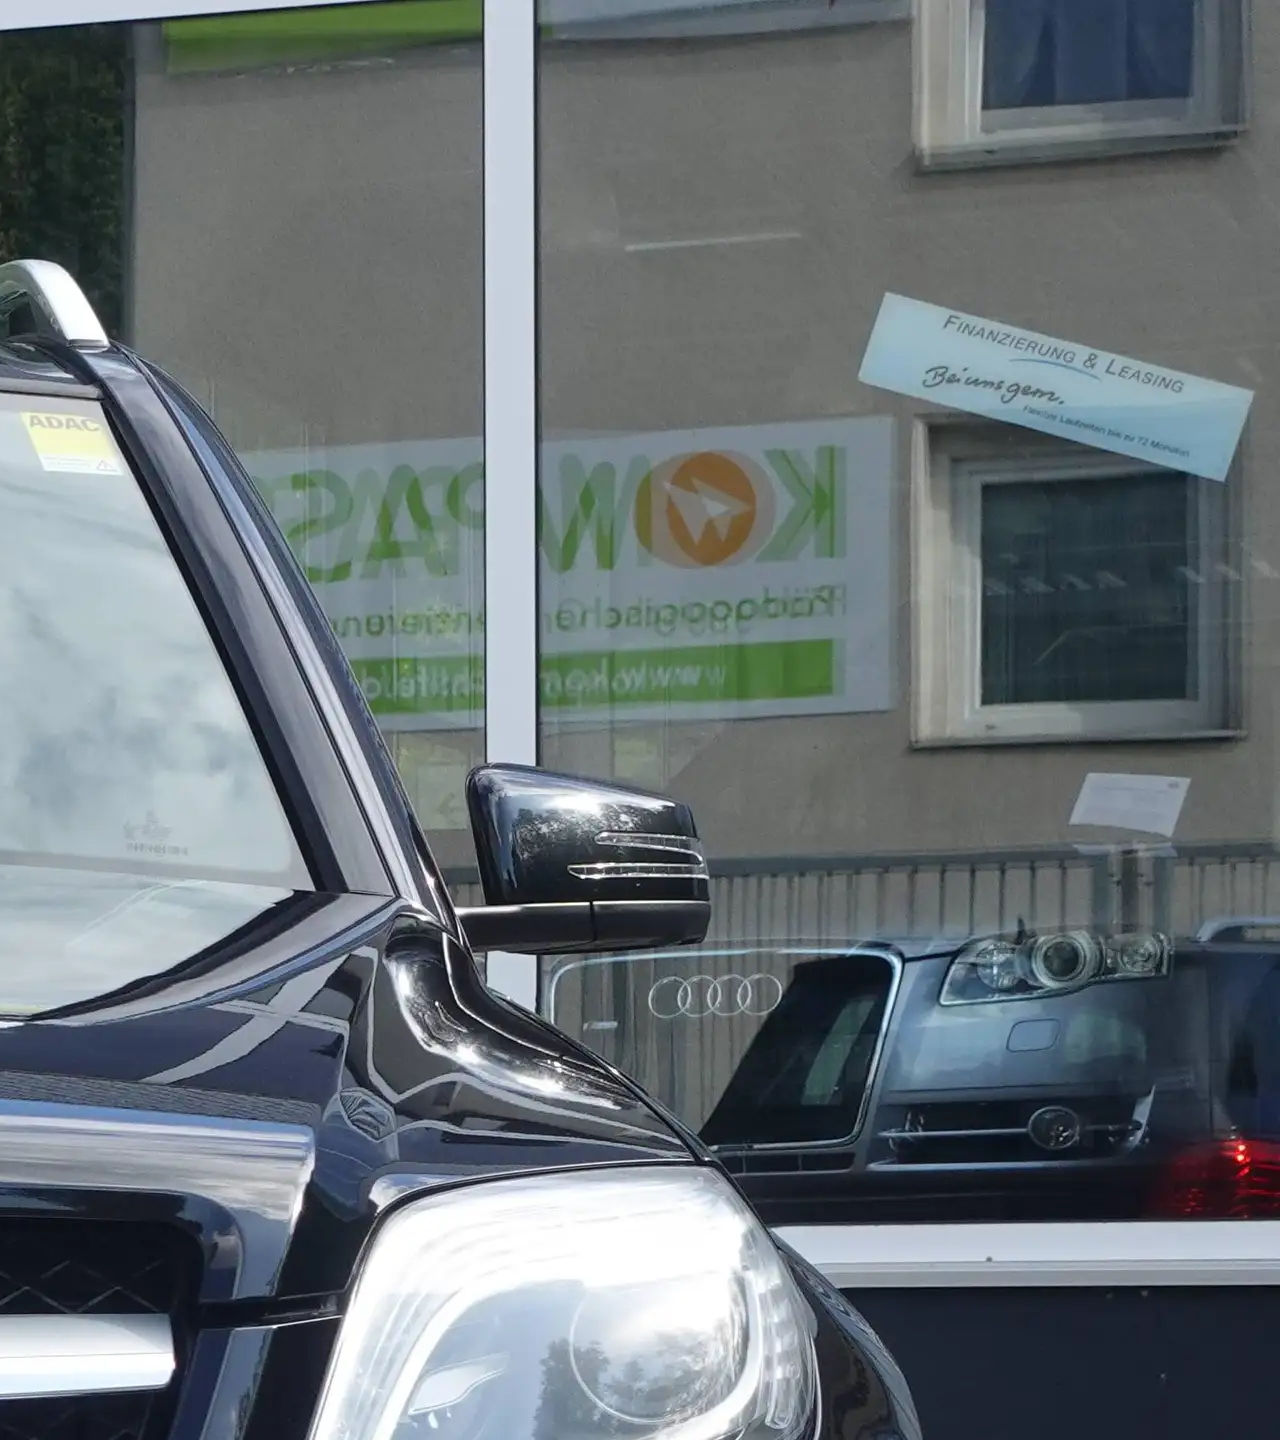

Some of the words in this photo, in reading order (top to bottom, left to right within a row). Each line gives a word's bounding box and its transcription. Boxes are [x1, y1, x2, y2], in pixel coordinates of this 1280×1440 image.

[942, 314, 1076, 364] FINANZIERUNG
[1083, 353, 1099, 369] &
[1105, 358, 1185, 394] LEASING
[29, 414, 101, 431] ADAC
